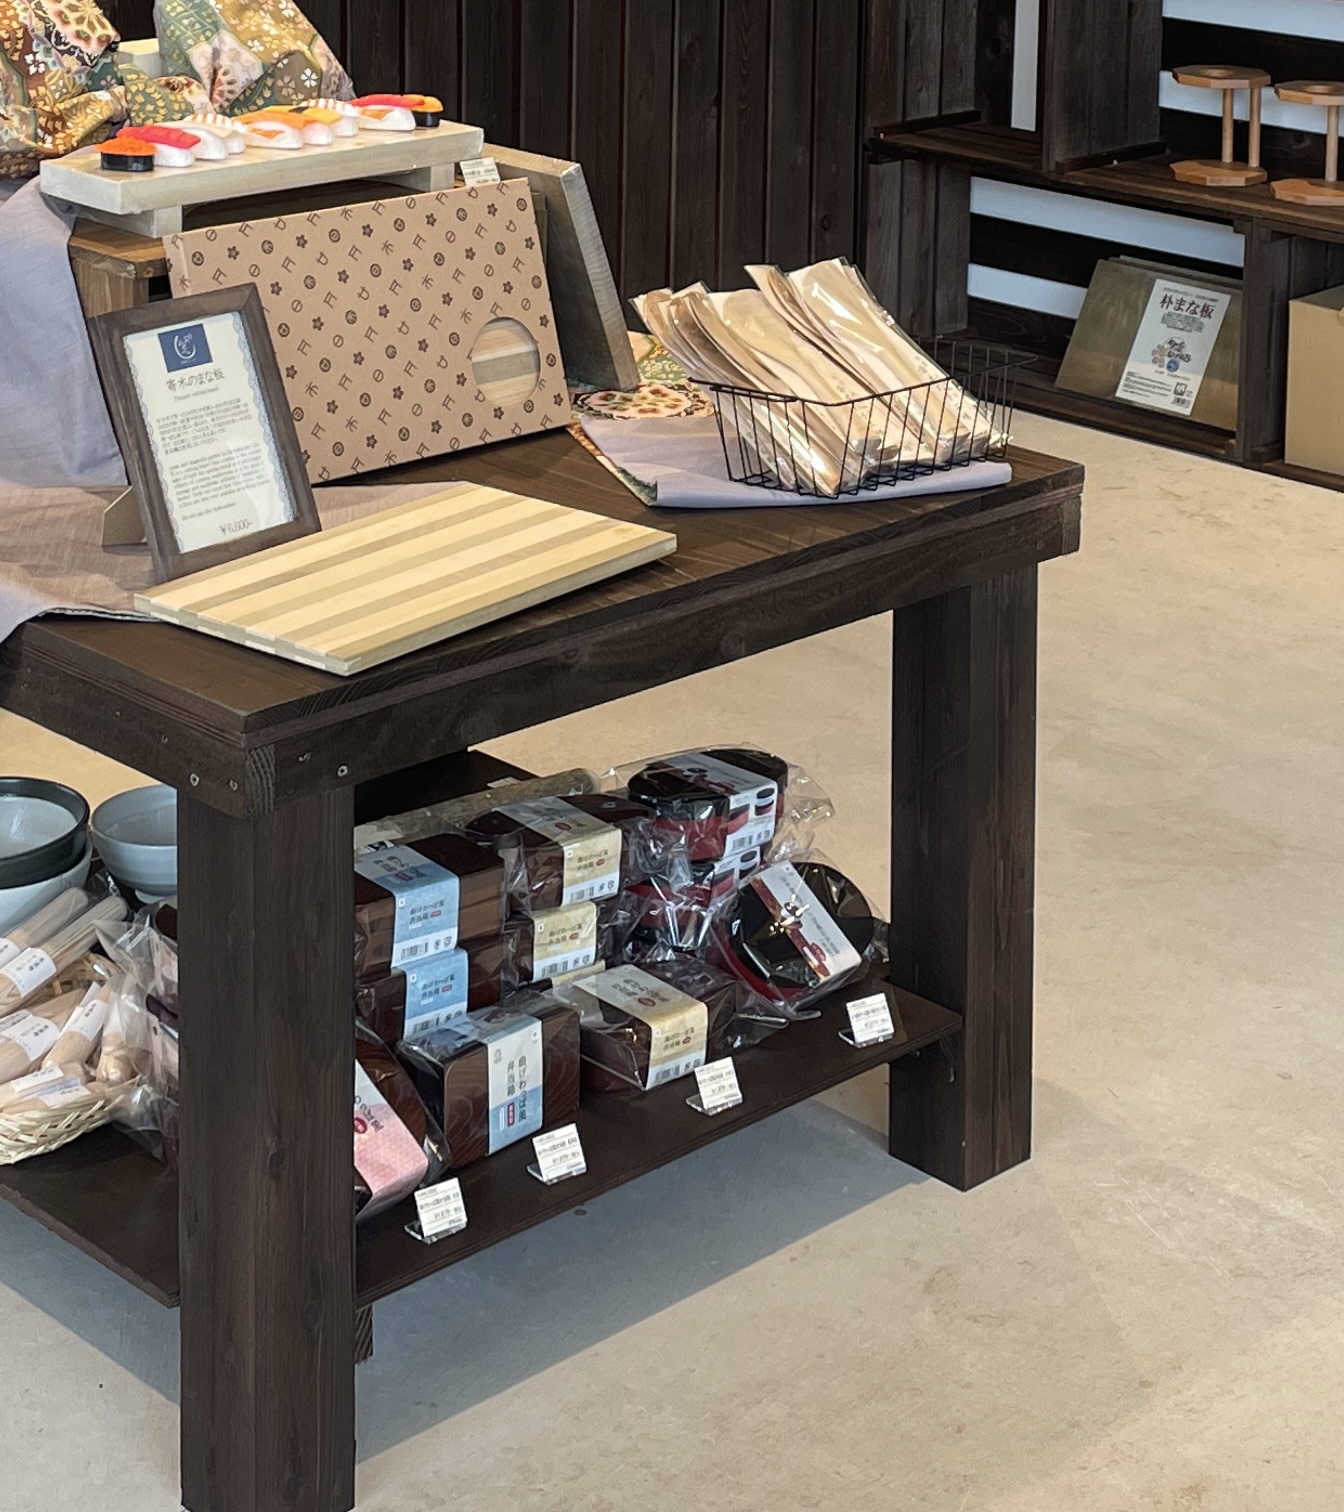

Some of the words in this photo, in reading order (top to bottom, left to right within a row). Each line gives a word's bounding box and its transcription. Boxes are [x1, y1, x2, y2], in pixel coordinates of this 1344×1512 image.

[165, 368, 226, 392] 寄木のまな板
